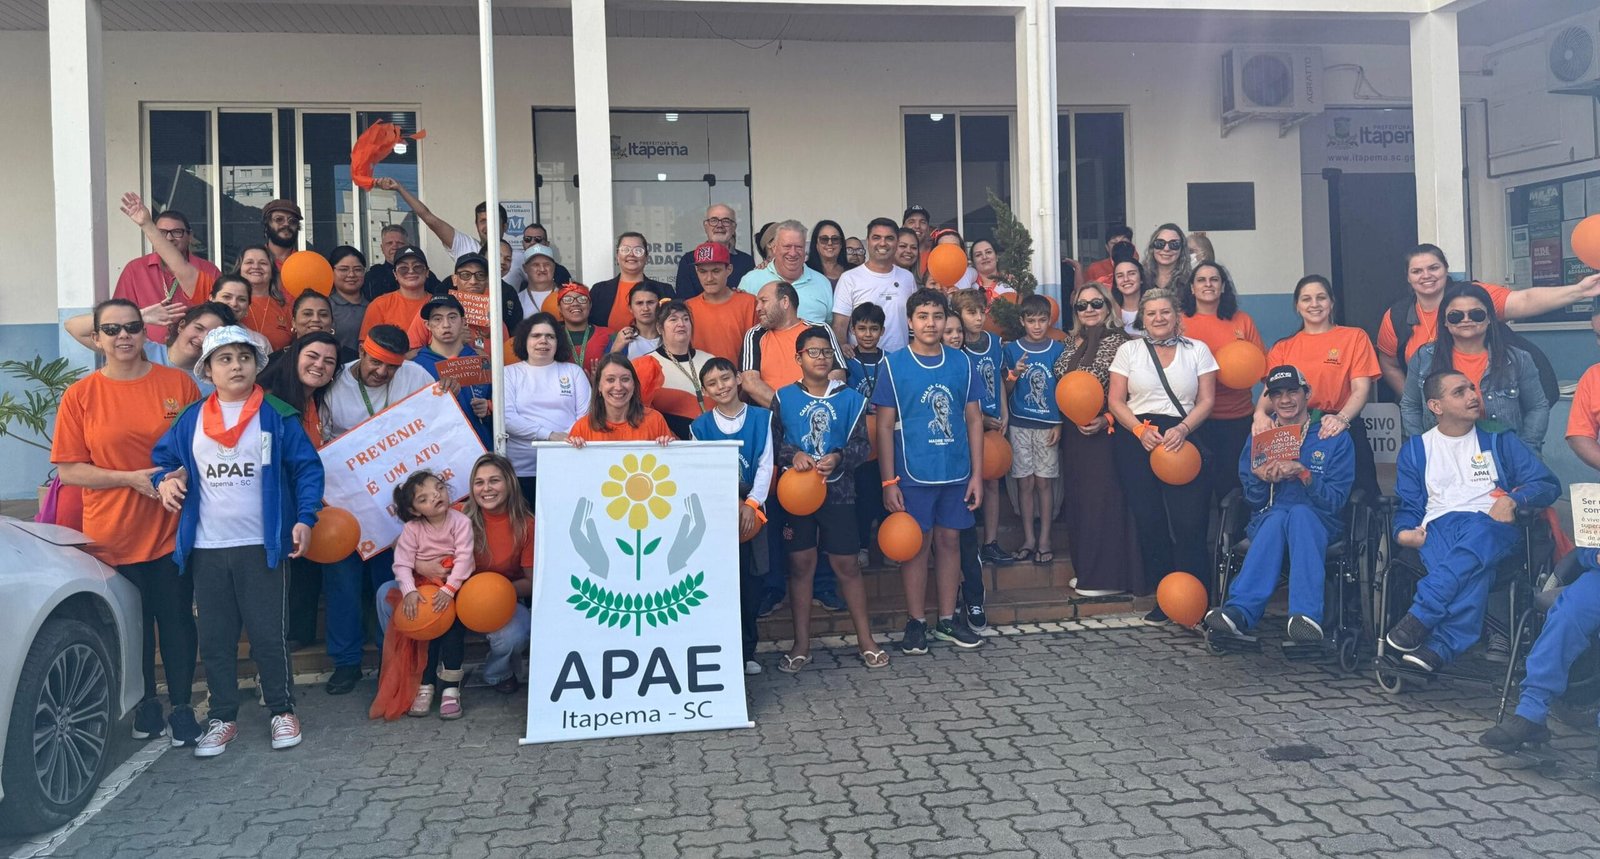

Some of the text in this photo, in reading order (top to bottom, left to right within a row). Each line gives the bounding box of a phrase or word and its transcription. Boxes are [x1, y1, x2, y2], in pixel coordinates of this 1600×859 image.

[1304, 56, 1313, 104] AGRATTO
[1360, 126, 1413, 148] Itape
[628, 142, 689, 159] Itapema
[1328, 154, 1415, 162] www.itapema.sc.go
[665, 243, 683, 252] DE
[809, 399, 818, 407] DA
[1365, 417, 1395, 431] SIVO
[345, 418, 426, 472] PREVENIR
[1271, 435, 1297, 445] AMOR
[206, 463, 255, 479] APAE
[366, 442, 441, 496] É UM ATO
[550, 645, 725, 702] APAE
[563, 708, 661, 731] Itapema
[683, 700, 713, 720] SC
